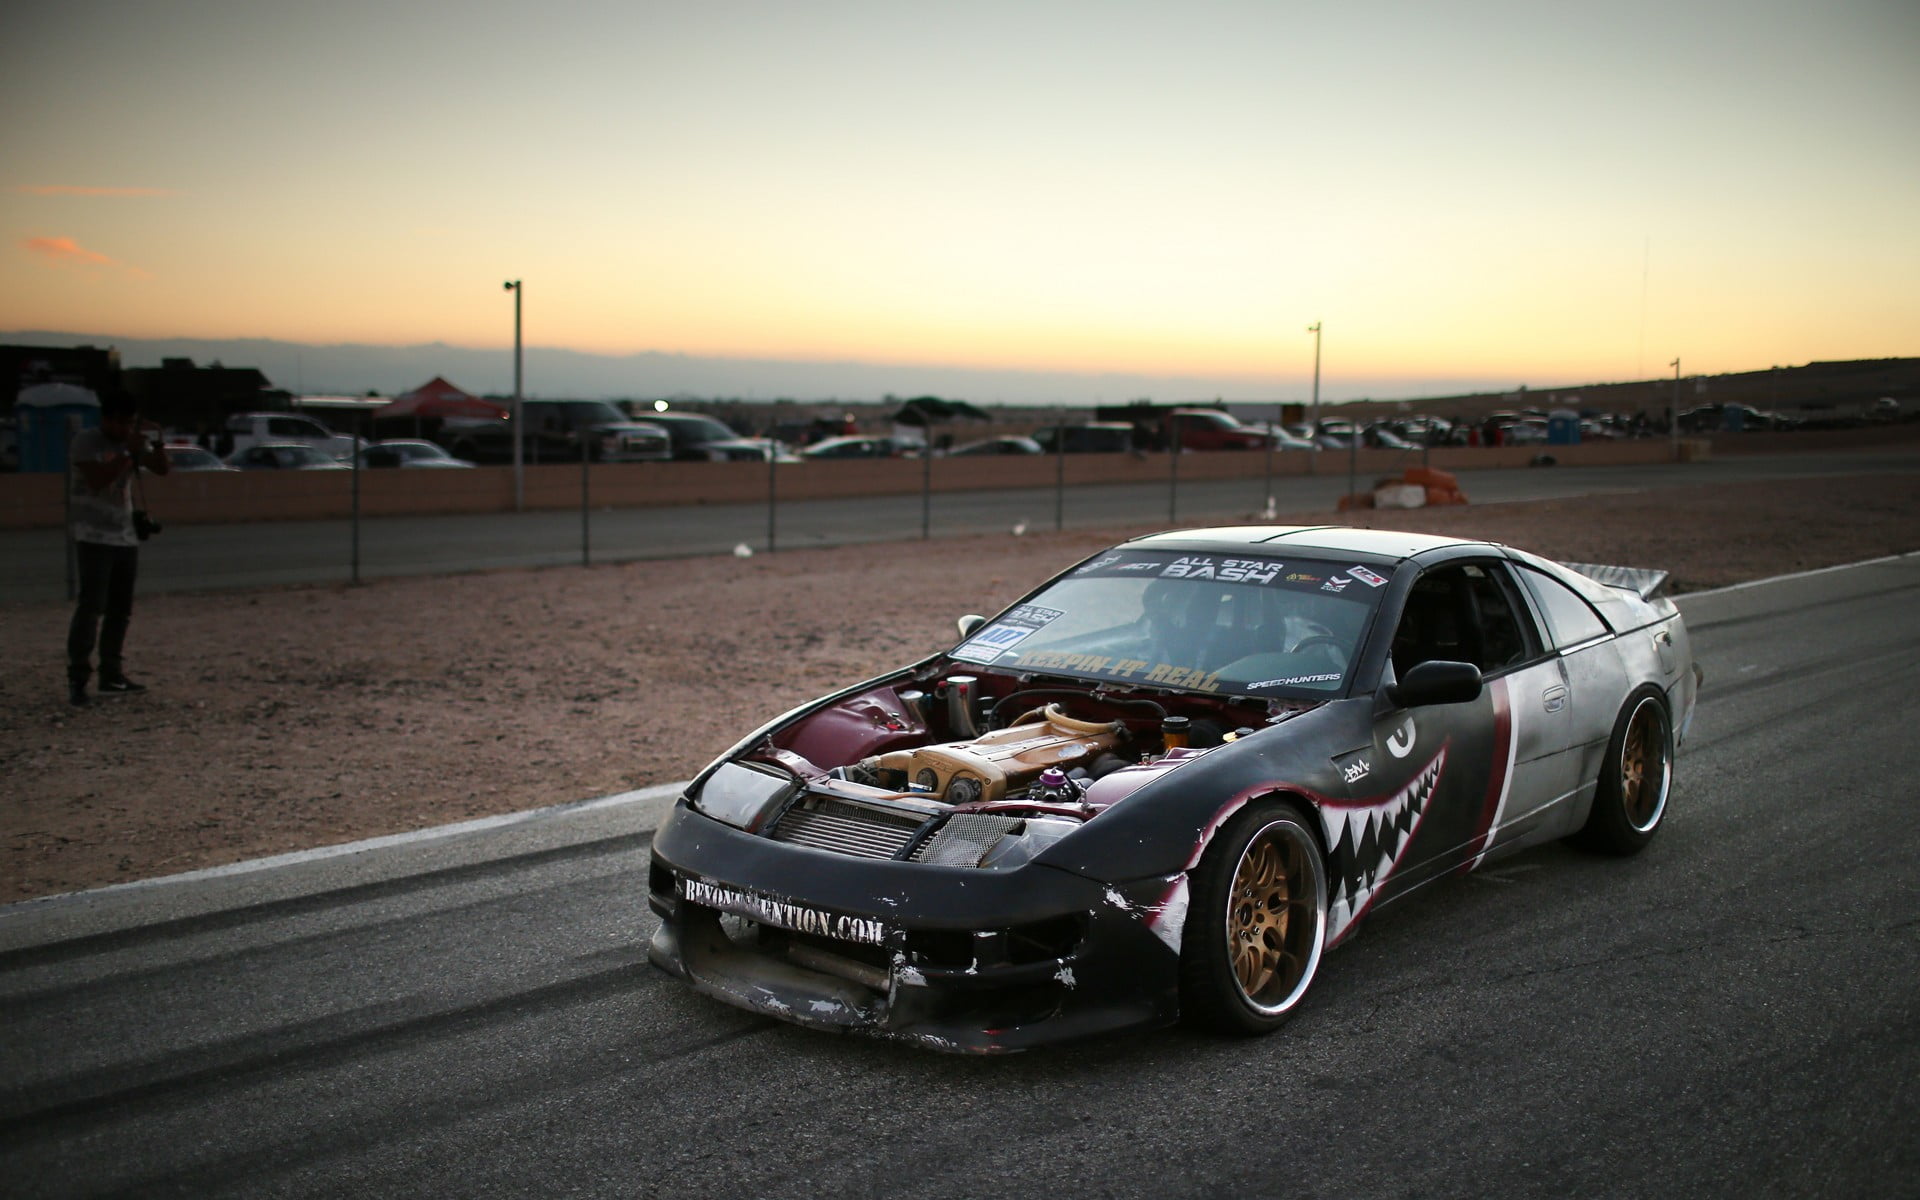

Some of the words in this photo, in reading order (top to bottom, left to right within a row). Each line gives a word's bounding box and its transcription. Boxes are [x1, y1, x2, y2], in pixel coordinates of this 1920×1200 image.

[1172, 557, 1214, 566] ALL
[1221, 559, 1284, 572] STAR
[1159, 564, 1279, 585] BASH
[1013, 651, 1112, 673] KEEPIN
[1108, 659, 1149, 677] IT
[1144, 663, 1221, 692] REAL
[1246, 673, 1341, 690] SPEEDHUNTERS
